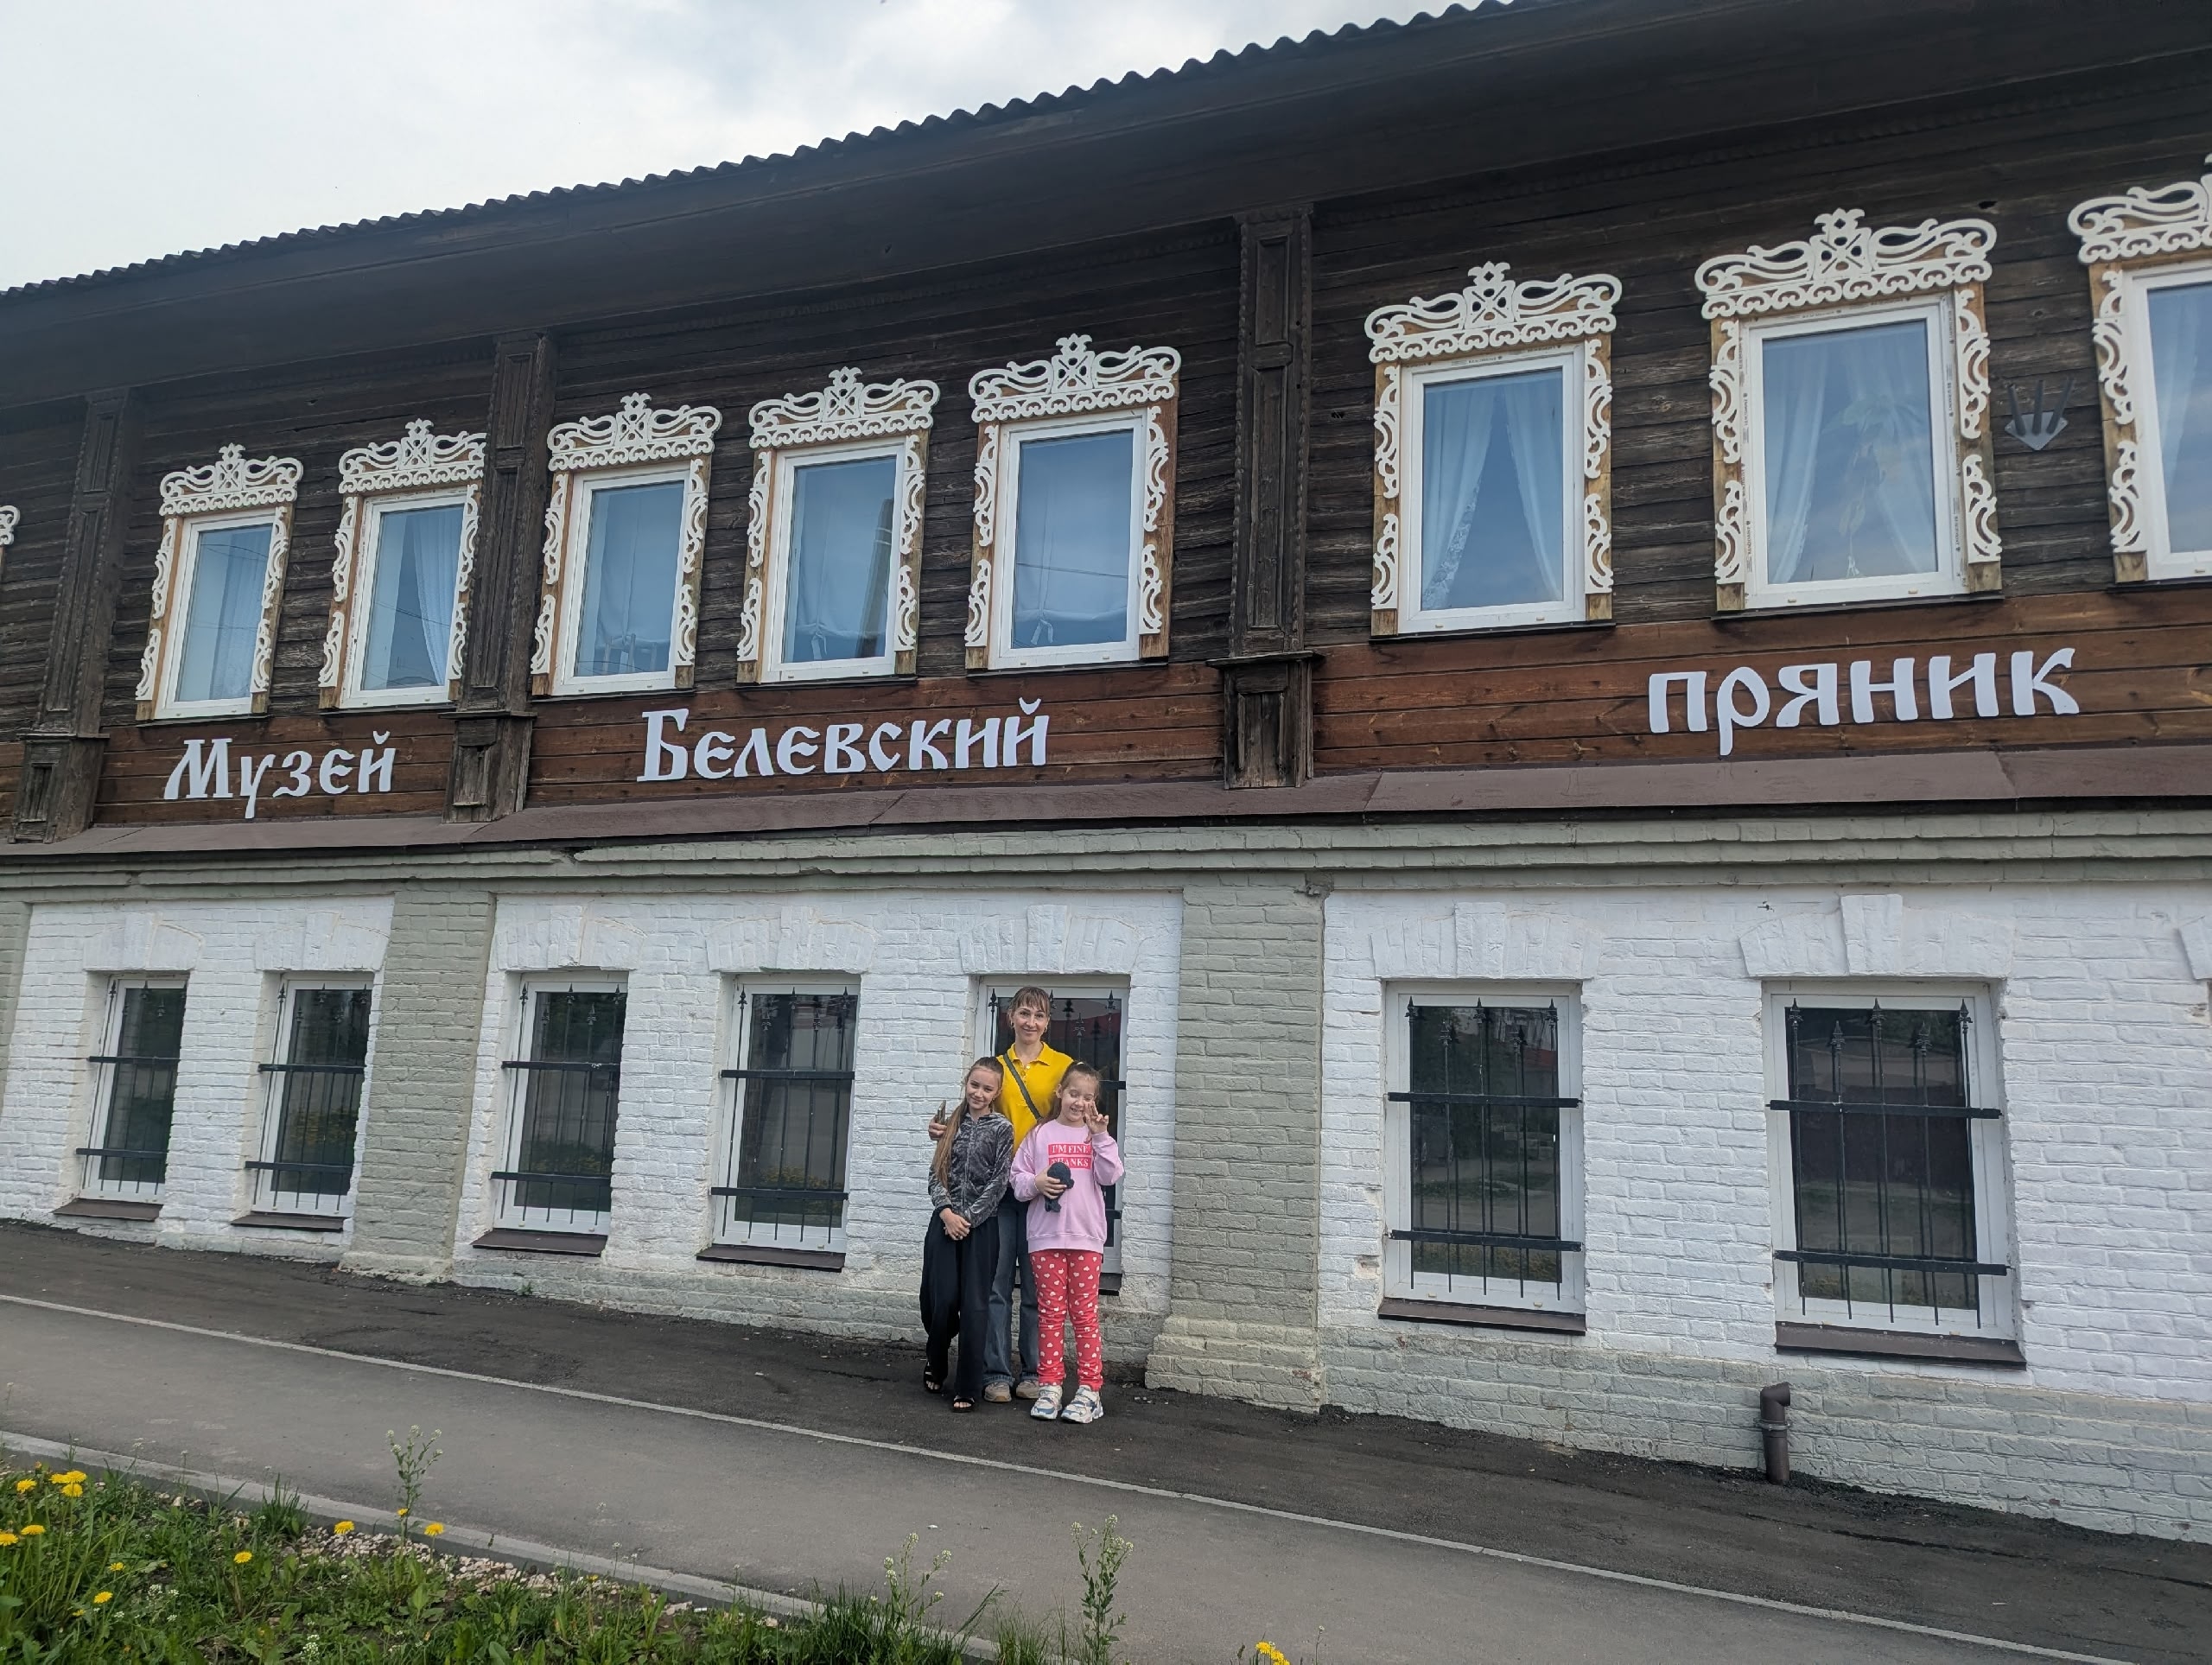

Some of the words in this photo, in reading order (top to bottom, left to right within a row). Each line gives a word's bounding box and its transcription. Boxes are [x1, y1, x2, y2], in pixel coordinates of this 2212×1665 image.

[163, 730, 397, 819] Музей
[636, 696, 1050, 783] Белевский
[1648, 647, 2080, 756] пряник
[1052, 1144, 1067, 1153] I'M
[1068, 1145, 1089, 1153] FINE
